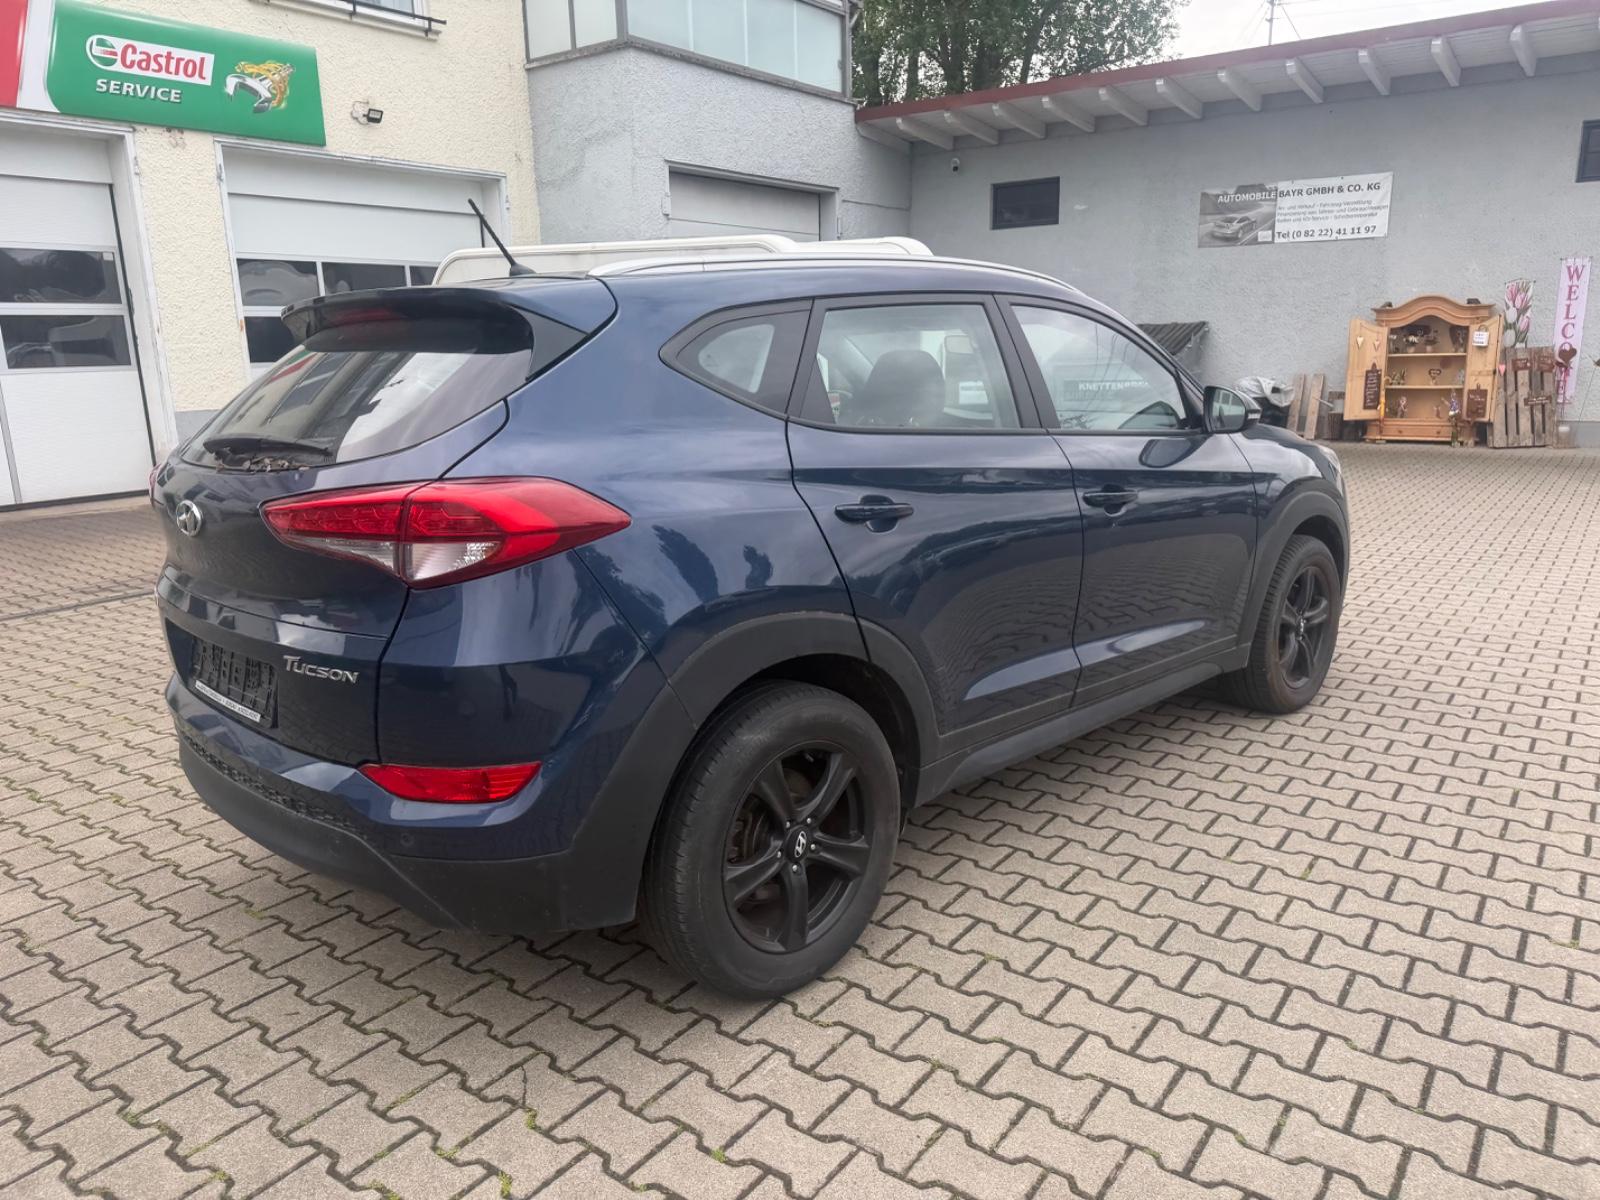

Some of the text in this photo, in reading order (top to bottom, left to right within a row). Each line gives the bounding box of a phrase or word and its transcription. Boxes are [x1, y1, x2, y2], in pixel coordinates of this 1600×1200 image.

[120, 43, 206, 80] Castrol
[96, 79, 182, 103] SERVICE
[1218, 182, 1382, 204] AUTOMOBILE BAYR GMBH & CO. KG
[1276, 231, 1290, 240] Tel
[1292, 230, 1302, 239] (0
[1304, 229, 1315, 238] 82
[1318, 228, 1333, 238] 22)
[1336, 227, 1347, 236] 41
[1350, 226, 1361, 235] 11
[1365, 225, 1377, 234] 97
[283, 655, 360, 684] TUCSON
